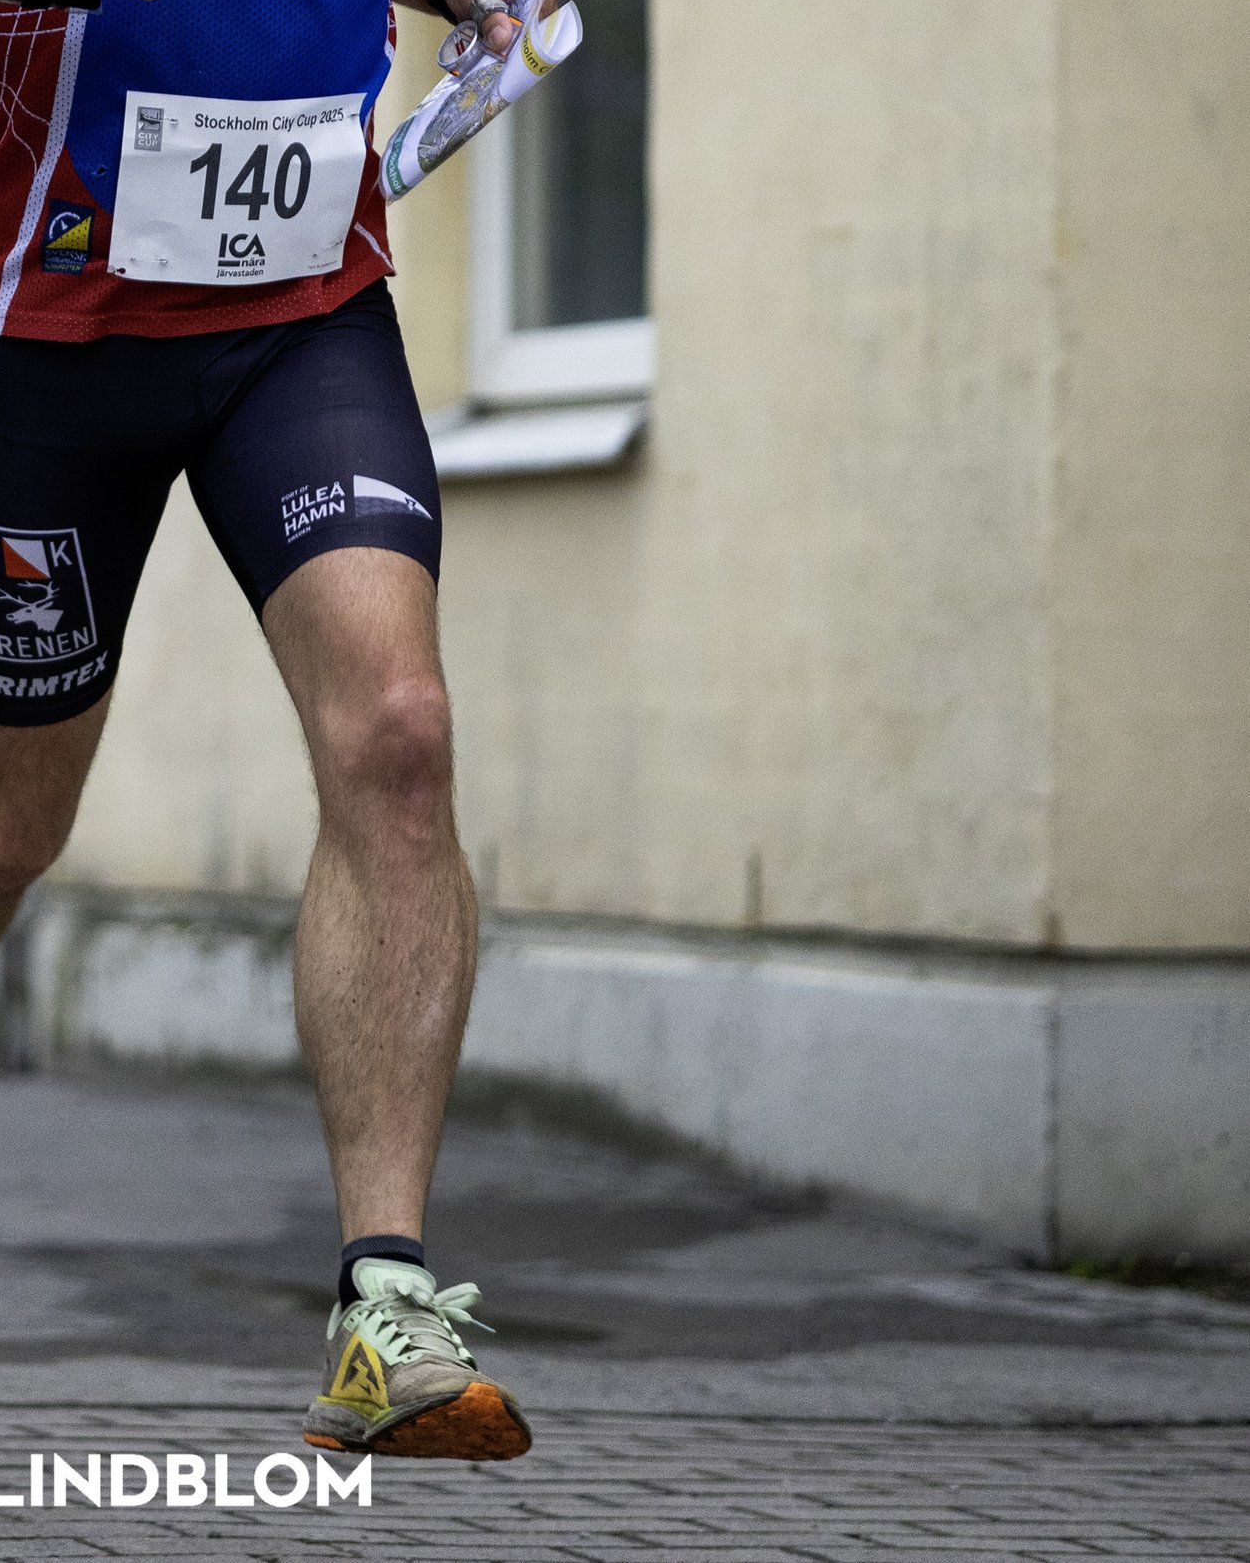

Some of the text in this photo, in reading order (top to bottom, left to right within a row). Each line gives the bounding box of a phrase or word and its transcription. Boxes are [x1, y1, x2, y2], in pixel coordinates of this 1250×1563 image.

[194, 107, 344, 133] Stockholm City Cup 2025
[137, 131, 159, 140] CITY
[137, 139, 159, 147] CUP
[189, 141, 312, 220] 140
[218, 233, 266, 258] ICA
[216, 269, 264, 278] Järvastaden
[241, 258, 266, 267] nära
[282, 481, 346, 519] LULEÅ
[284, 499, 345, 536] HAMN
[50, 540, 73, 568] K
